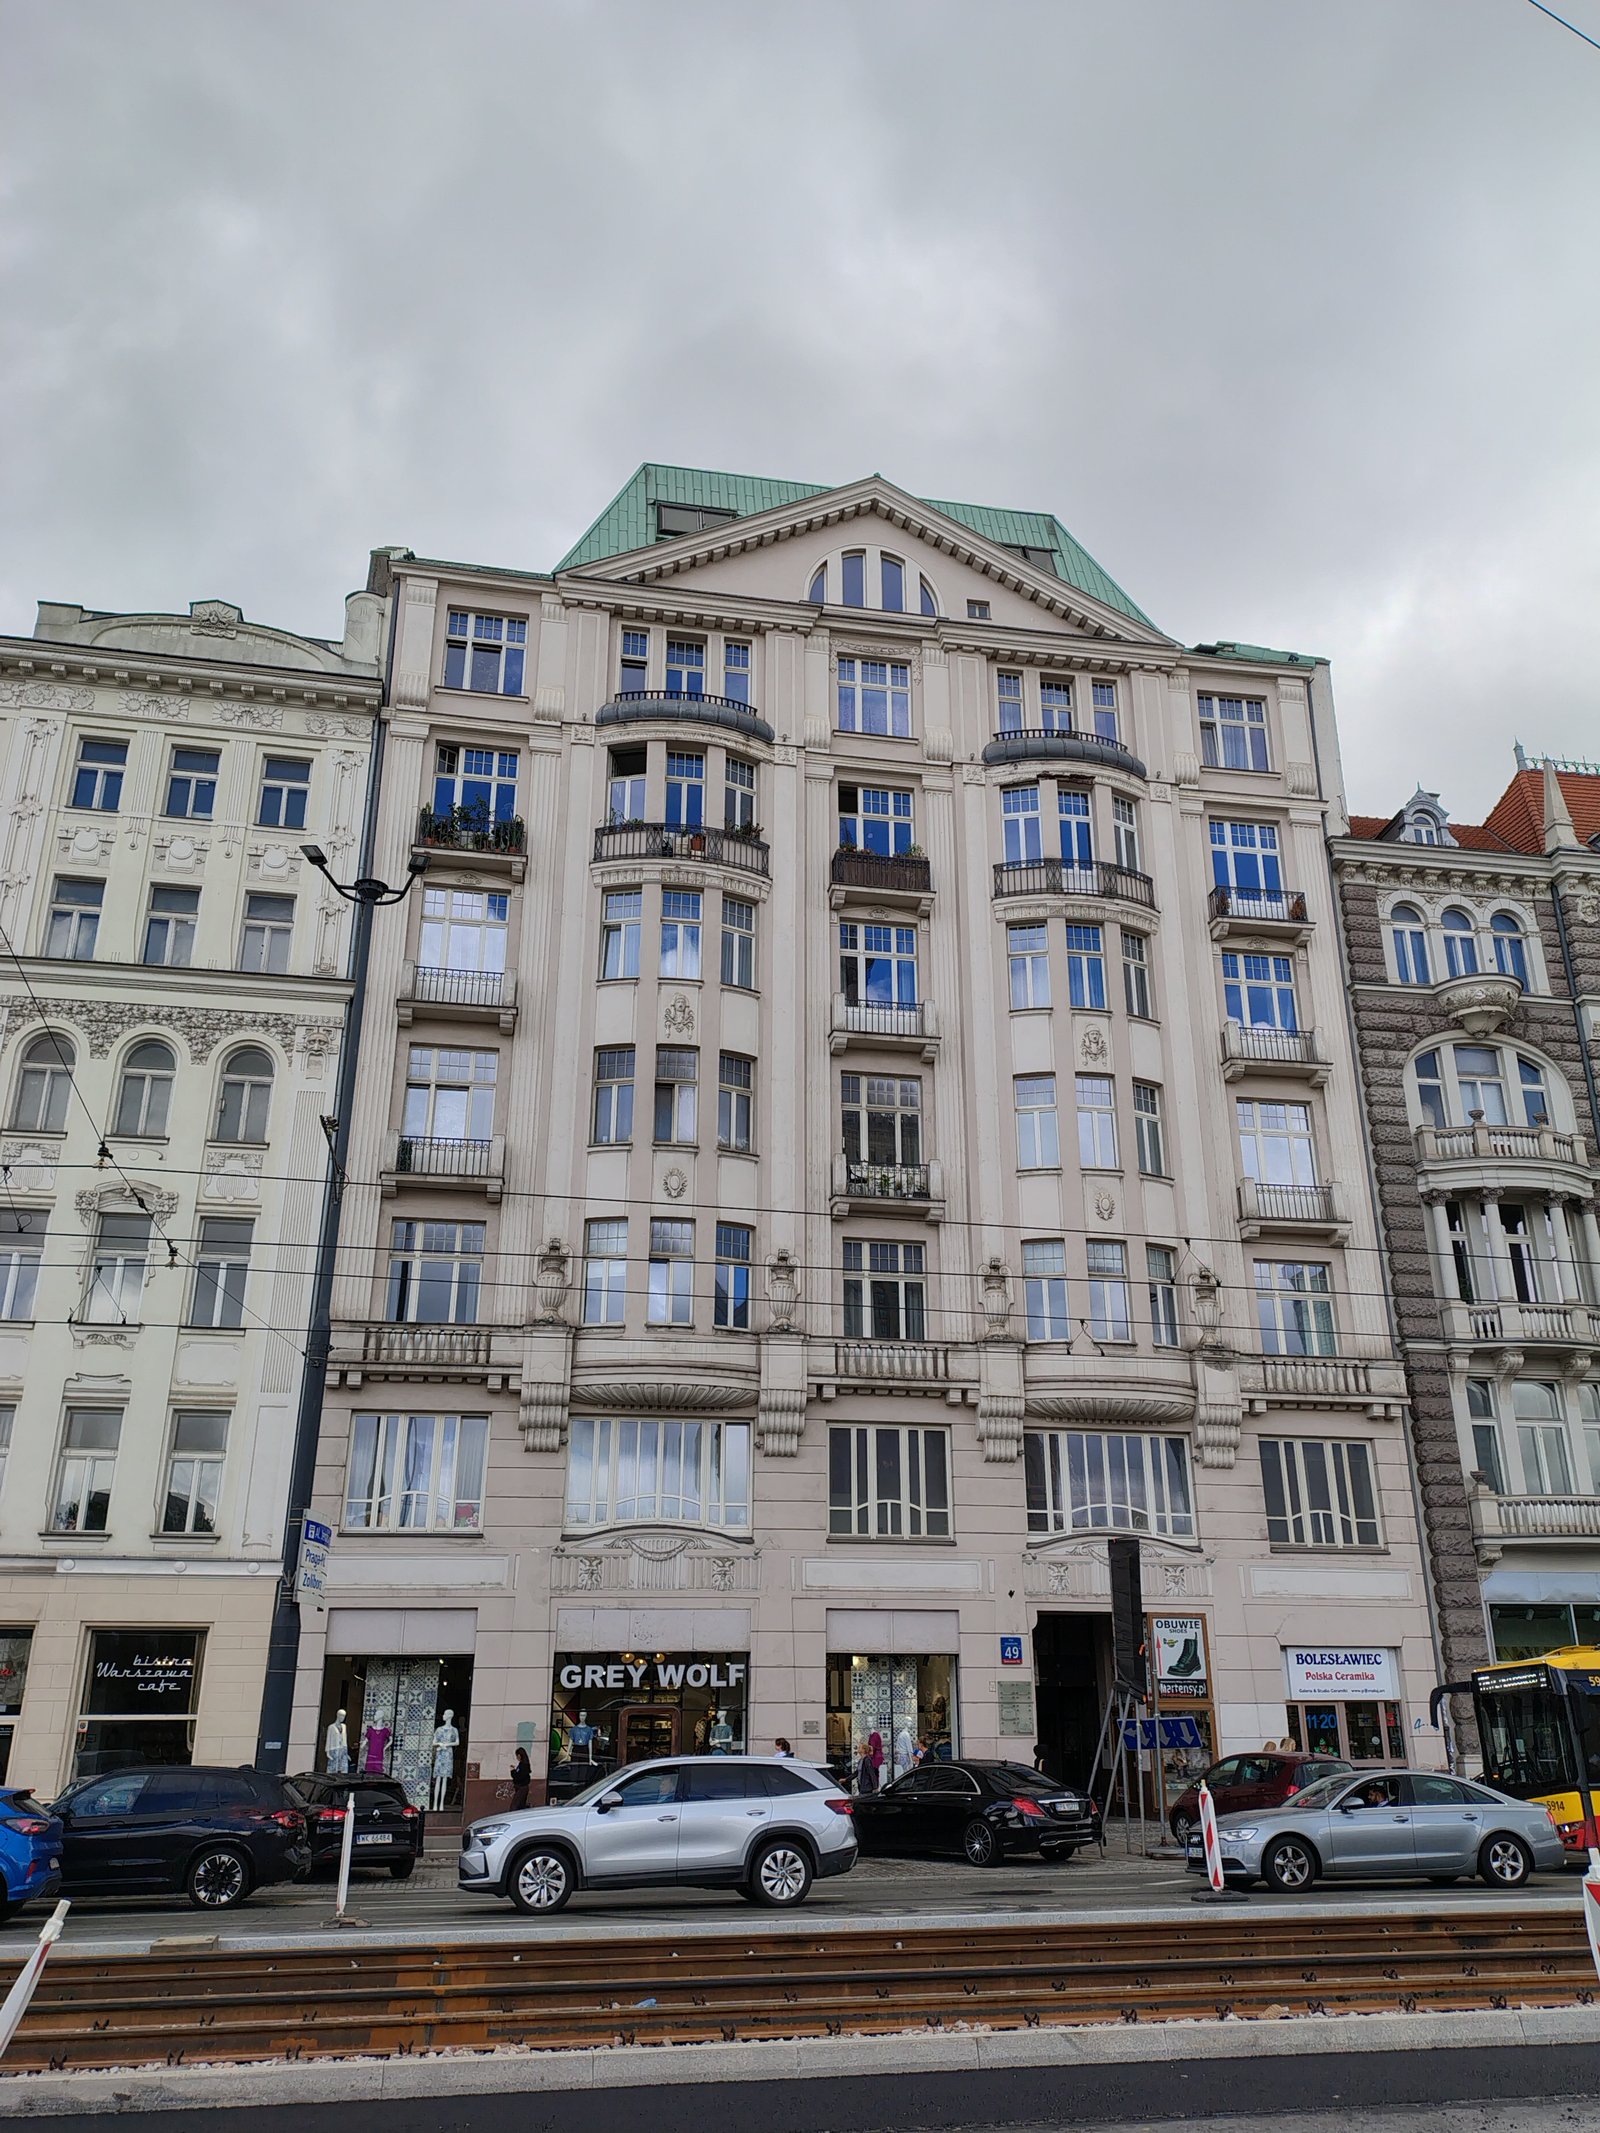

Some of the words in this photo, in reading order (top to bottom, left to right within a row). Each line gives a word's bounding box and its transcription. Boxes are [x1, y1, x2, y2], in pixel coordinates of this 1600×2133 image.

[1155, 1620, 1201, 1629] OBUWIE
[1004, 1646, 1019, 1659] 49
[132, 1654, 194, 1666] bistro
[1295, 1653, 1382, 1666] BOLESŁAWIEC
[96, 1662, 193, 1677] Warszawa
[560, 1664, 648, 1689] GREY
[656, 1663, 745, 1688] WOLF
[1305, 1671, 1333, 1680] Polska
[1335, 1671, 1375, 1681] Ceramika
[137, 1679, 181, 1693] cafe
[1159, 1682, 1207, 1697] Martensy.pl
[1546, 1800, 1565, 1811] 5914
